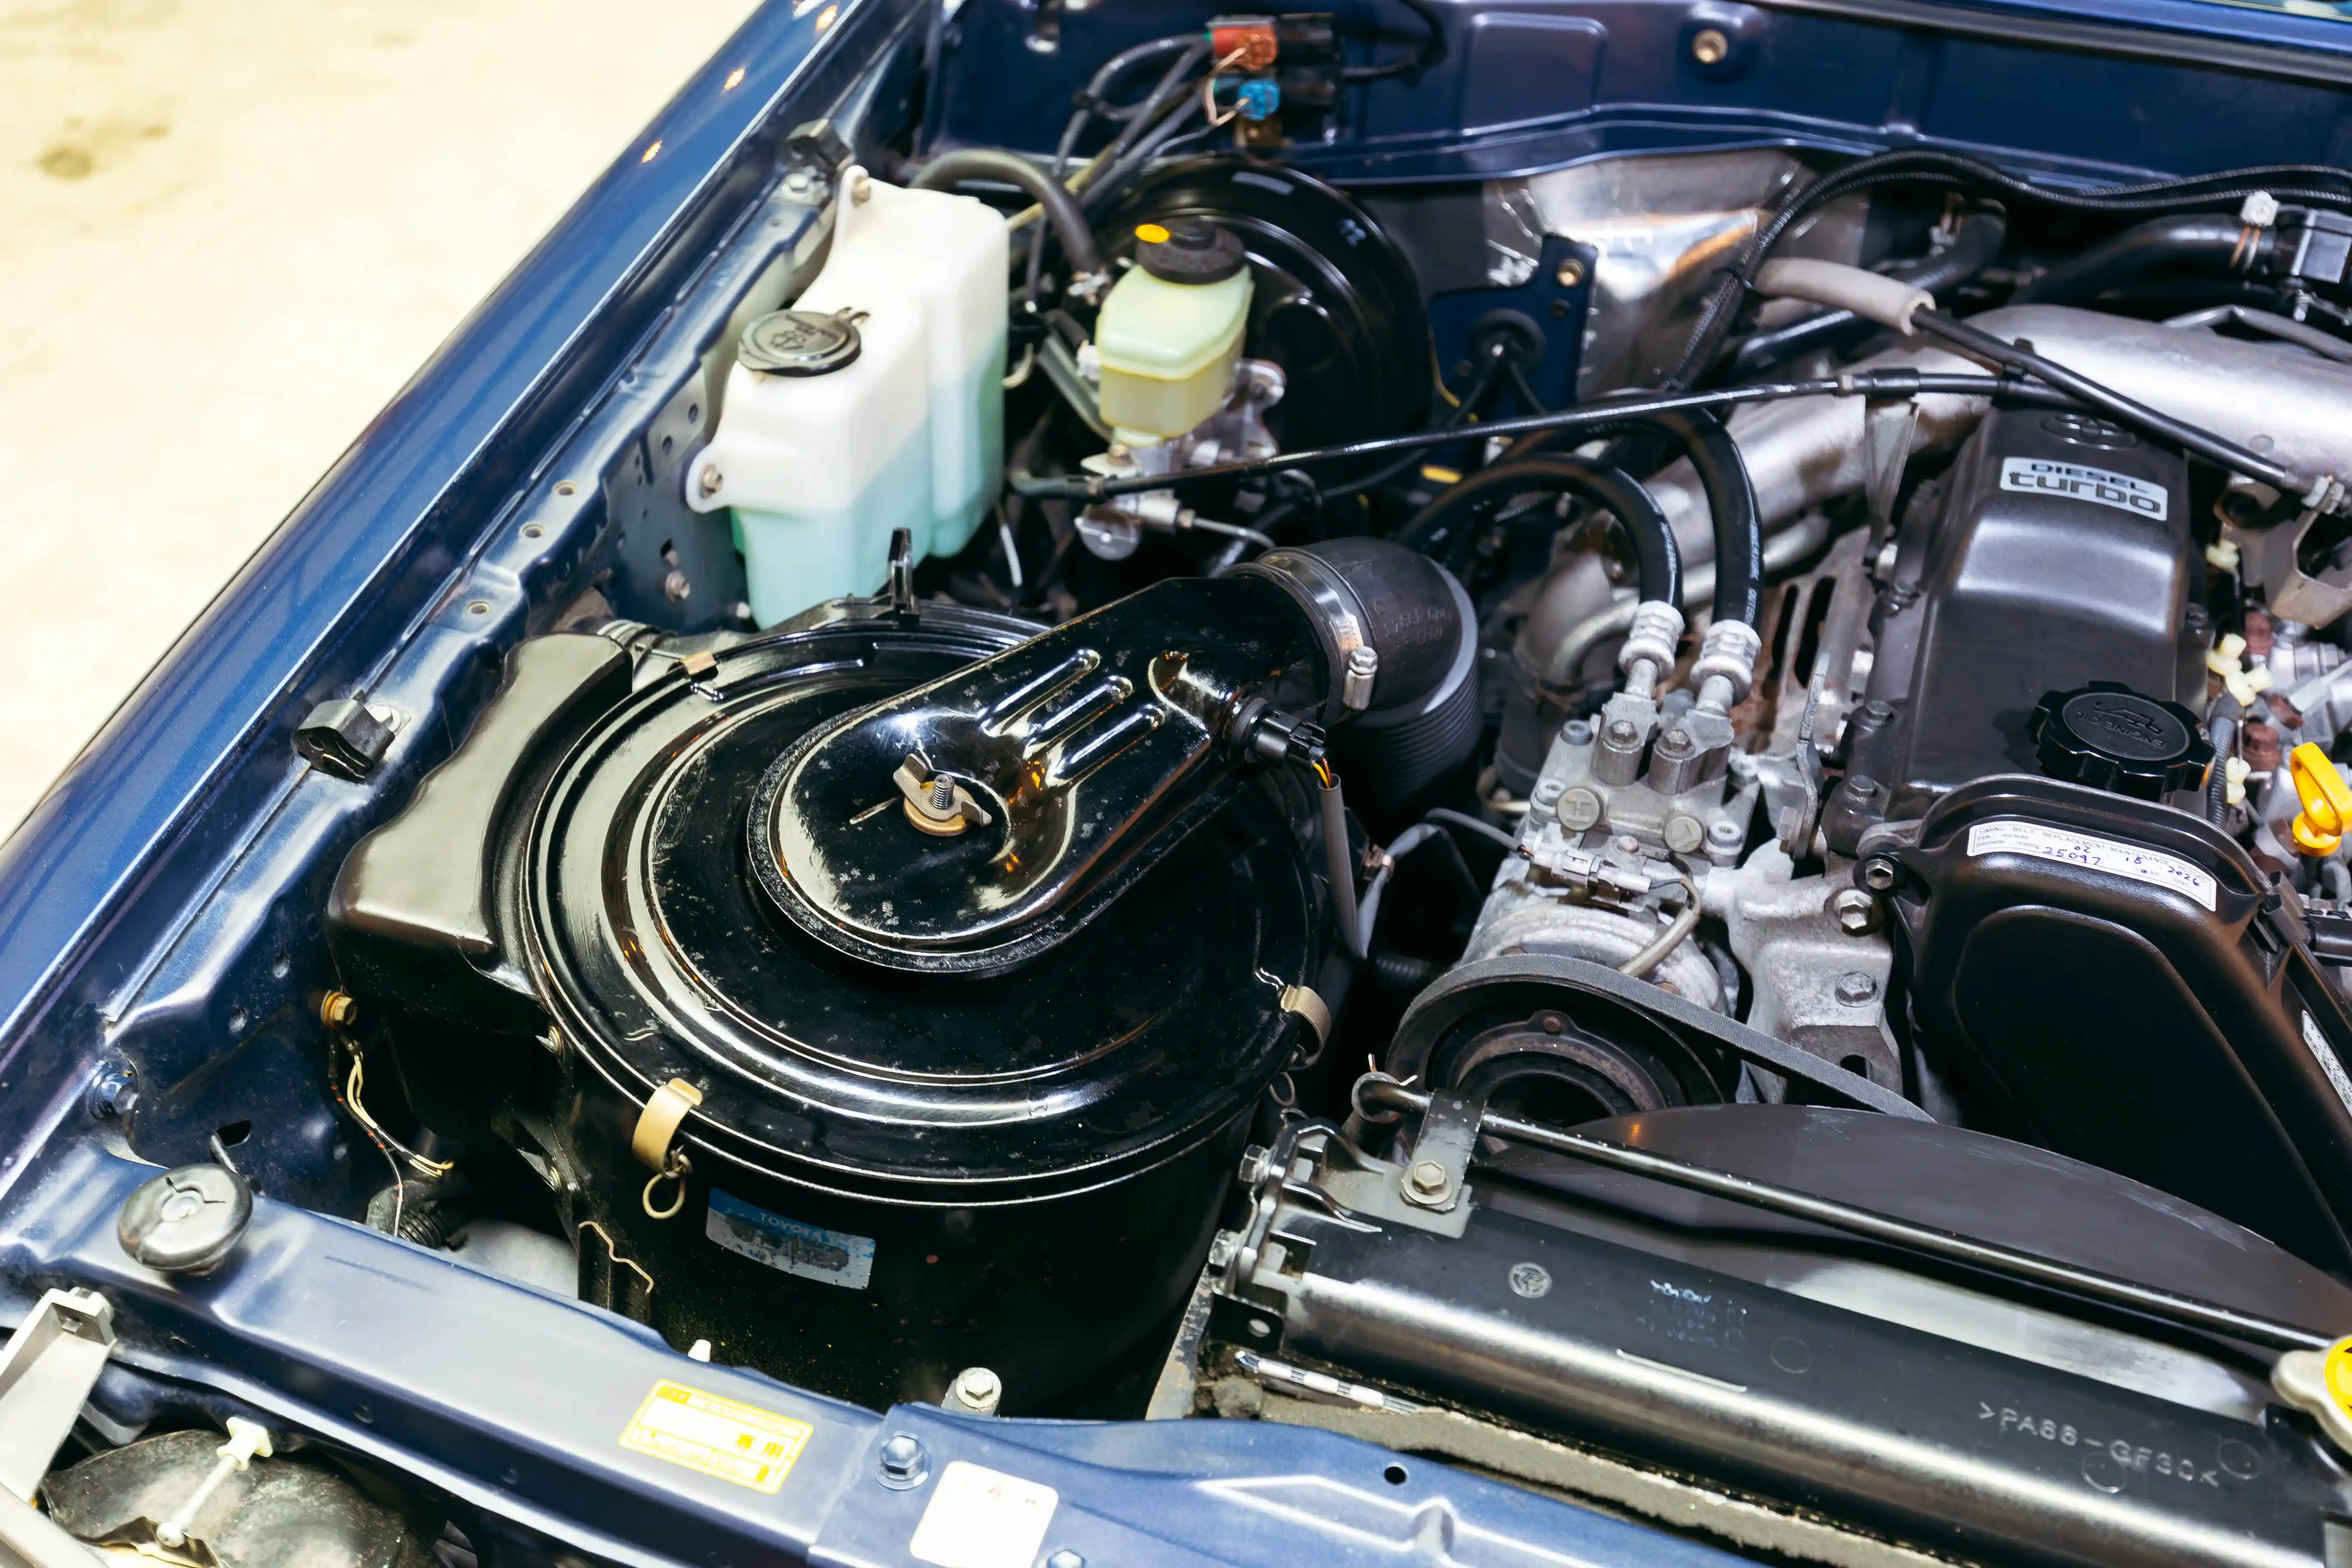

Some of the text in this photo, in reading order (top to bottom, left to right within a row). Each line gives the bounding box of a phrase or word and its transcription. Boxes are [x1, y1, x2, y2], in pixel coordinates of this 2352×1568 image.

[2009, 472, 2161, 514] turbo
[2031, 463, 2148, 494] DIESEL
[2076, 711, 2166, 749] ENGINE OIL
[2042, 831, 2105, 850] REPLACEMENT
[2168, 866, 2200, 886] 2026
[759, 1212, 823, 1242] TOYOTA
